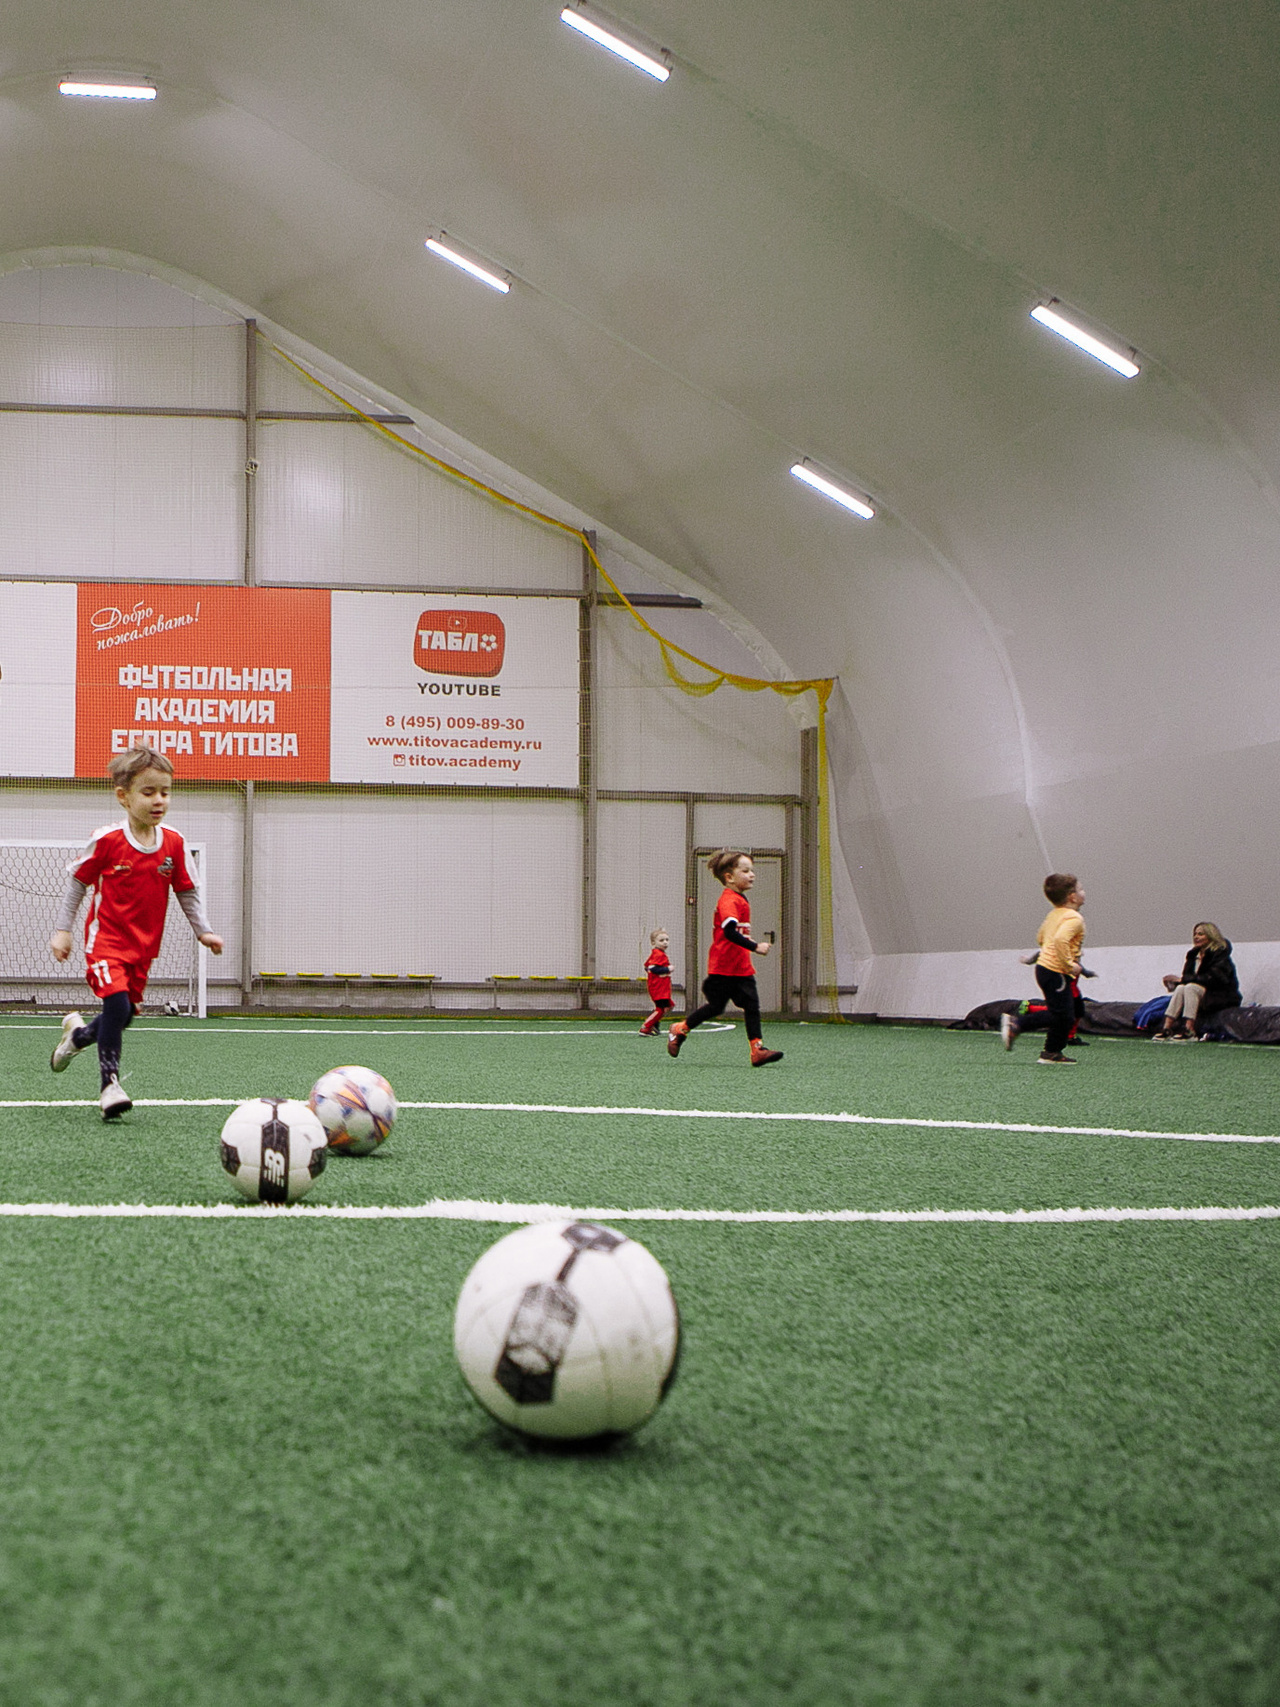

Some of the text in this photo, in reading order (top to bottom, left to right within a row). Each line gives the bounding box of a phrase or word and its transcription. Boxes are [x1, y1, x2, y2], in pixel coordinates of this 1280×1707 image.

[90, 600, 153, 634] Добро
[96, 601, 200, 651] пожаловать!
[118, 664, 292, 692] ФУТБОЛЬНАЯ
[417, 682, 501, 697] YOUTUBE
[134, 697, 275, 725] АКАДЕМИЯ
[385, 715, 525, 731] 8 (495) 009-89-30
[199, 731, 299, 757] ТИТОВА
[367, 735, 542, 752] www.titovacademy.ru
[408, 755, 521, 771] titov.academy
